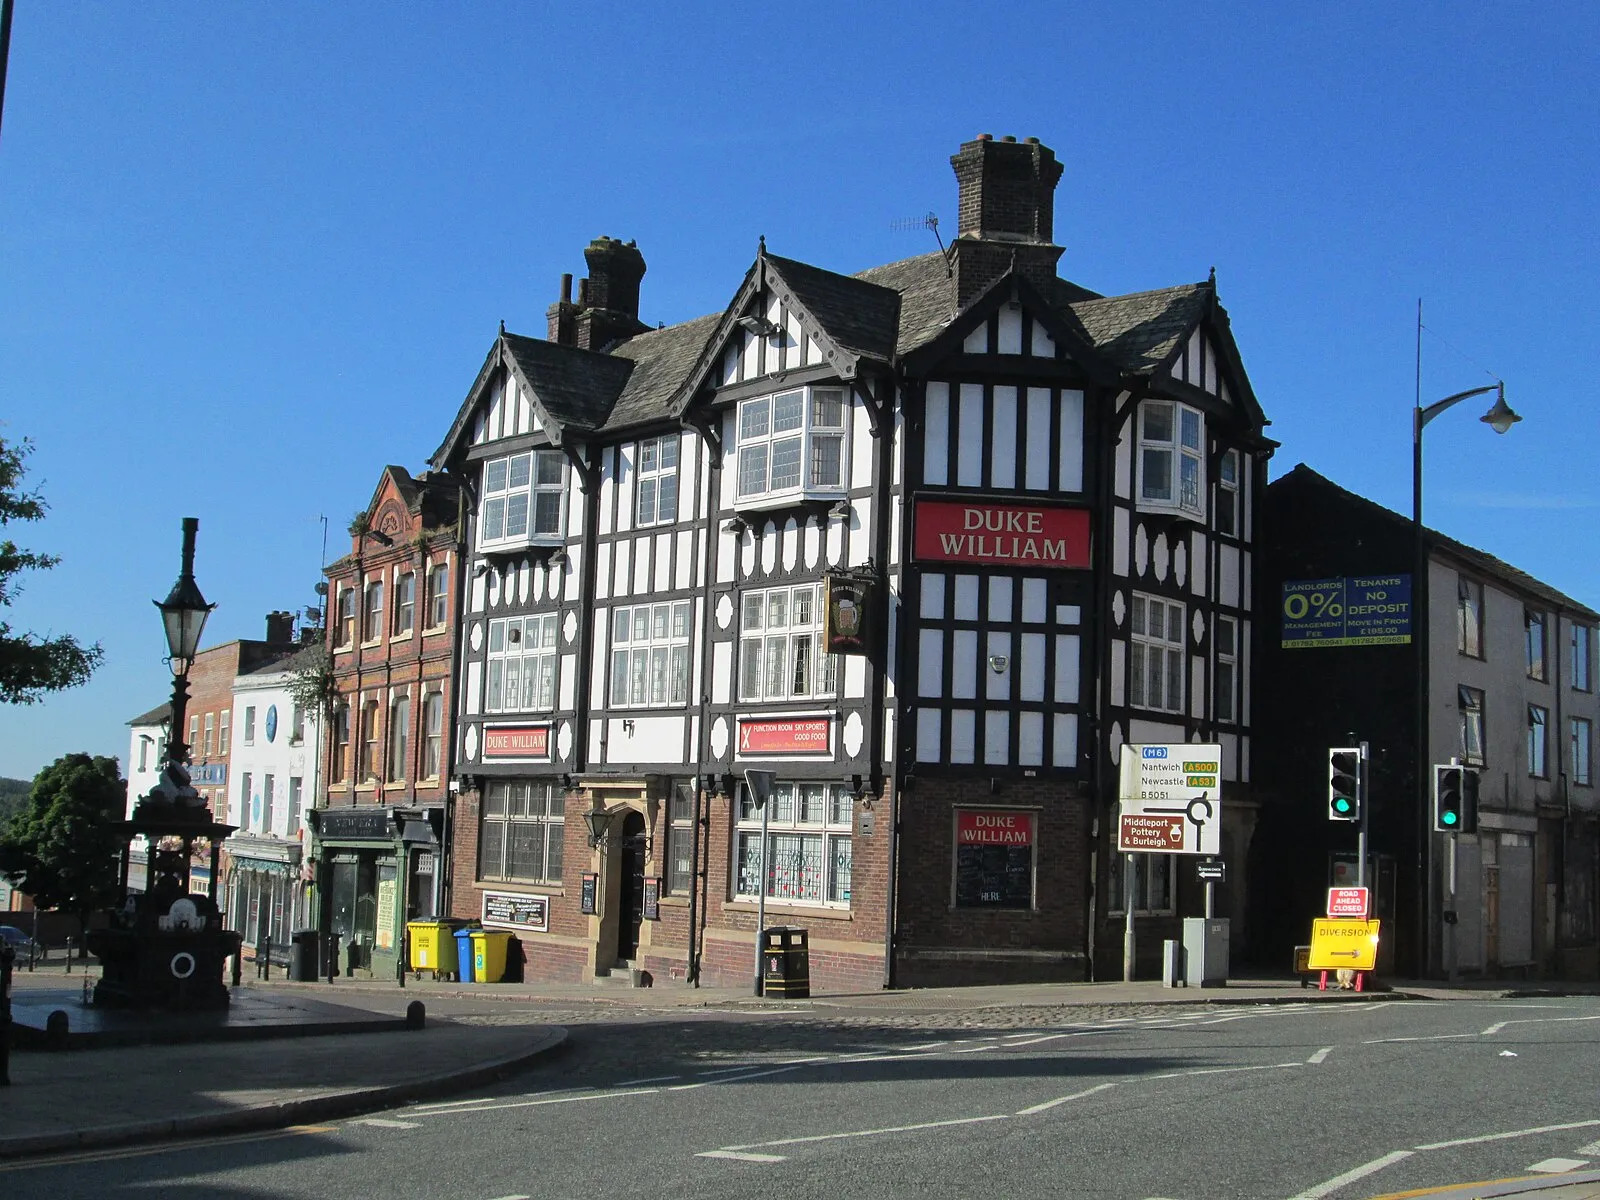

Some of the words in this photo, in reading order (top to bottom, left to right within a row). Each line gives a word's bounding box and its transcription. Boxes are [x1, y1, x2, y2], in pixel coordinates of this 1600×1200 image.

[964, 508, 1044, 534] DUKE
[939, 533, 1066, 561] WILLIAM
[1284, 582, 1343, 592] LANDLORDS
[1354, 578, 1401, 587] TENANTS
[1366, 591, 1387, 601] NO
[1284, 591, 1343, 619] 0%
[1348, 603, 1409, 615] DEPOSIT
[1284, 621, 1342, 629] MANAGEMENT
[753, 724, 777, 732] FUNCTION
[777, 723, 793, 731] ROOM
[805, 723, 826, 731] SPORTS
[487, 736, 508, 748] DUKE
[511, 735, 545, 748] WILLIAM
[794, 733, 810, 741] GOOD
[810, 732, 826, 740] FOOD
[1141, 763, 1180, 771] Nantwich
[1141, 777, 1185, 785] Newcastle
[976, 816, 1016, 828] DUKE
[1124, 818, 1169, 828] Middleport
[964, 830, 1026, 842] WILLIAM
[1131, 827, 1161, 838] Pottery
[1124, 837, 1130, 845] &
[1133, 837, 1167, 847] Burleigh
[1319, 928, 1372, 937] DIVERSION
